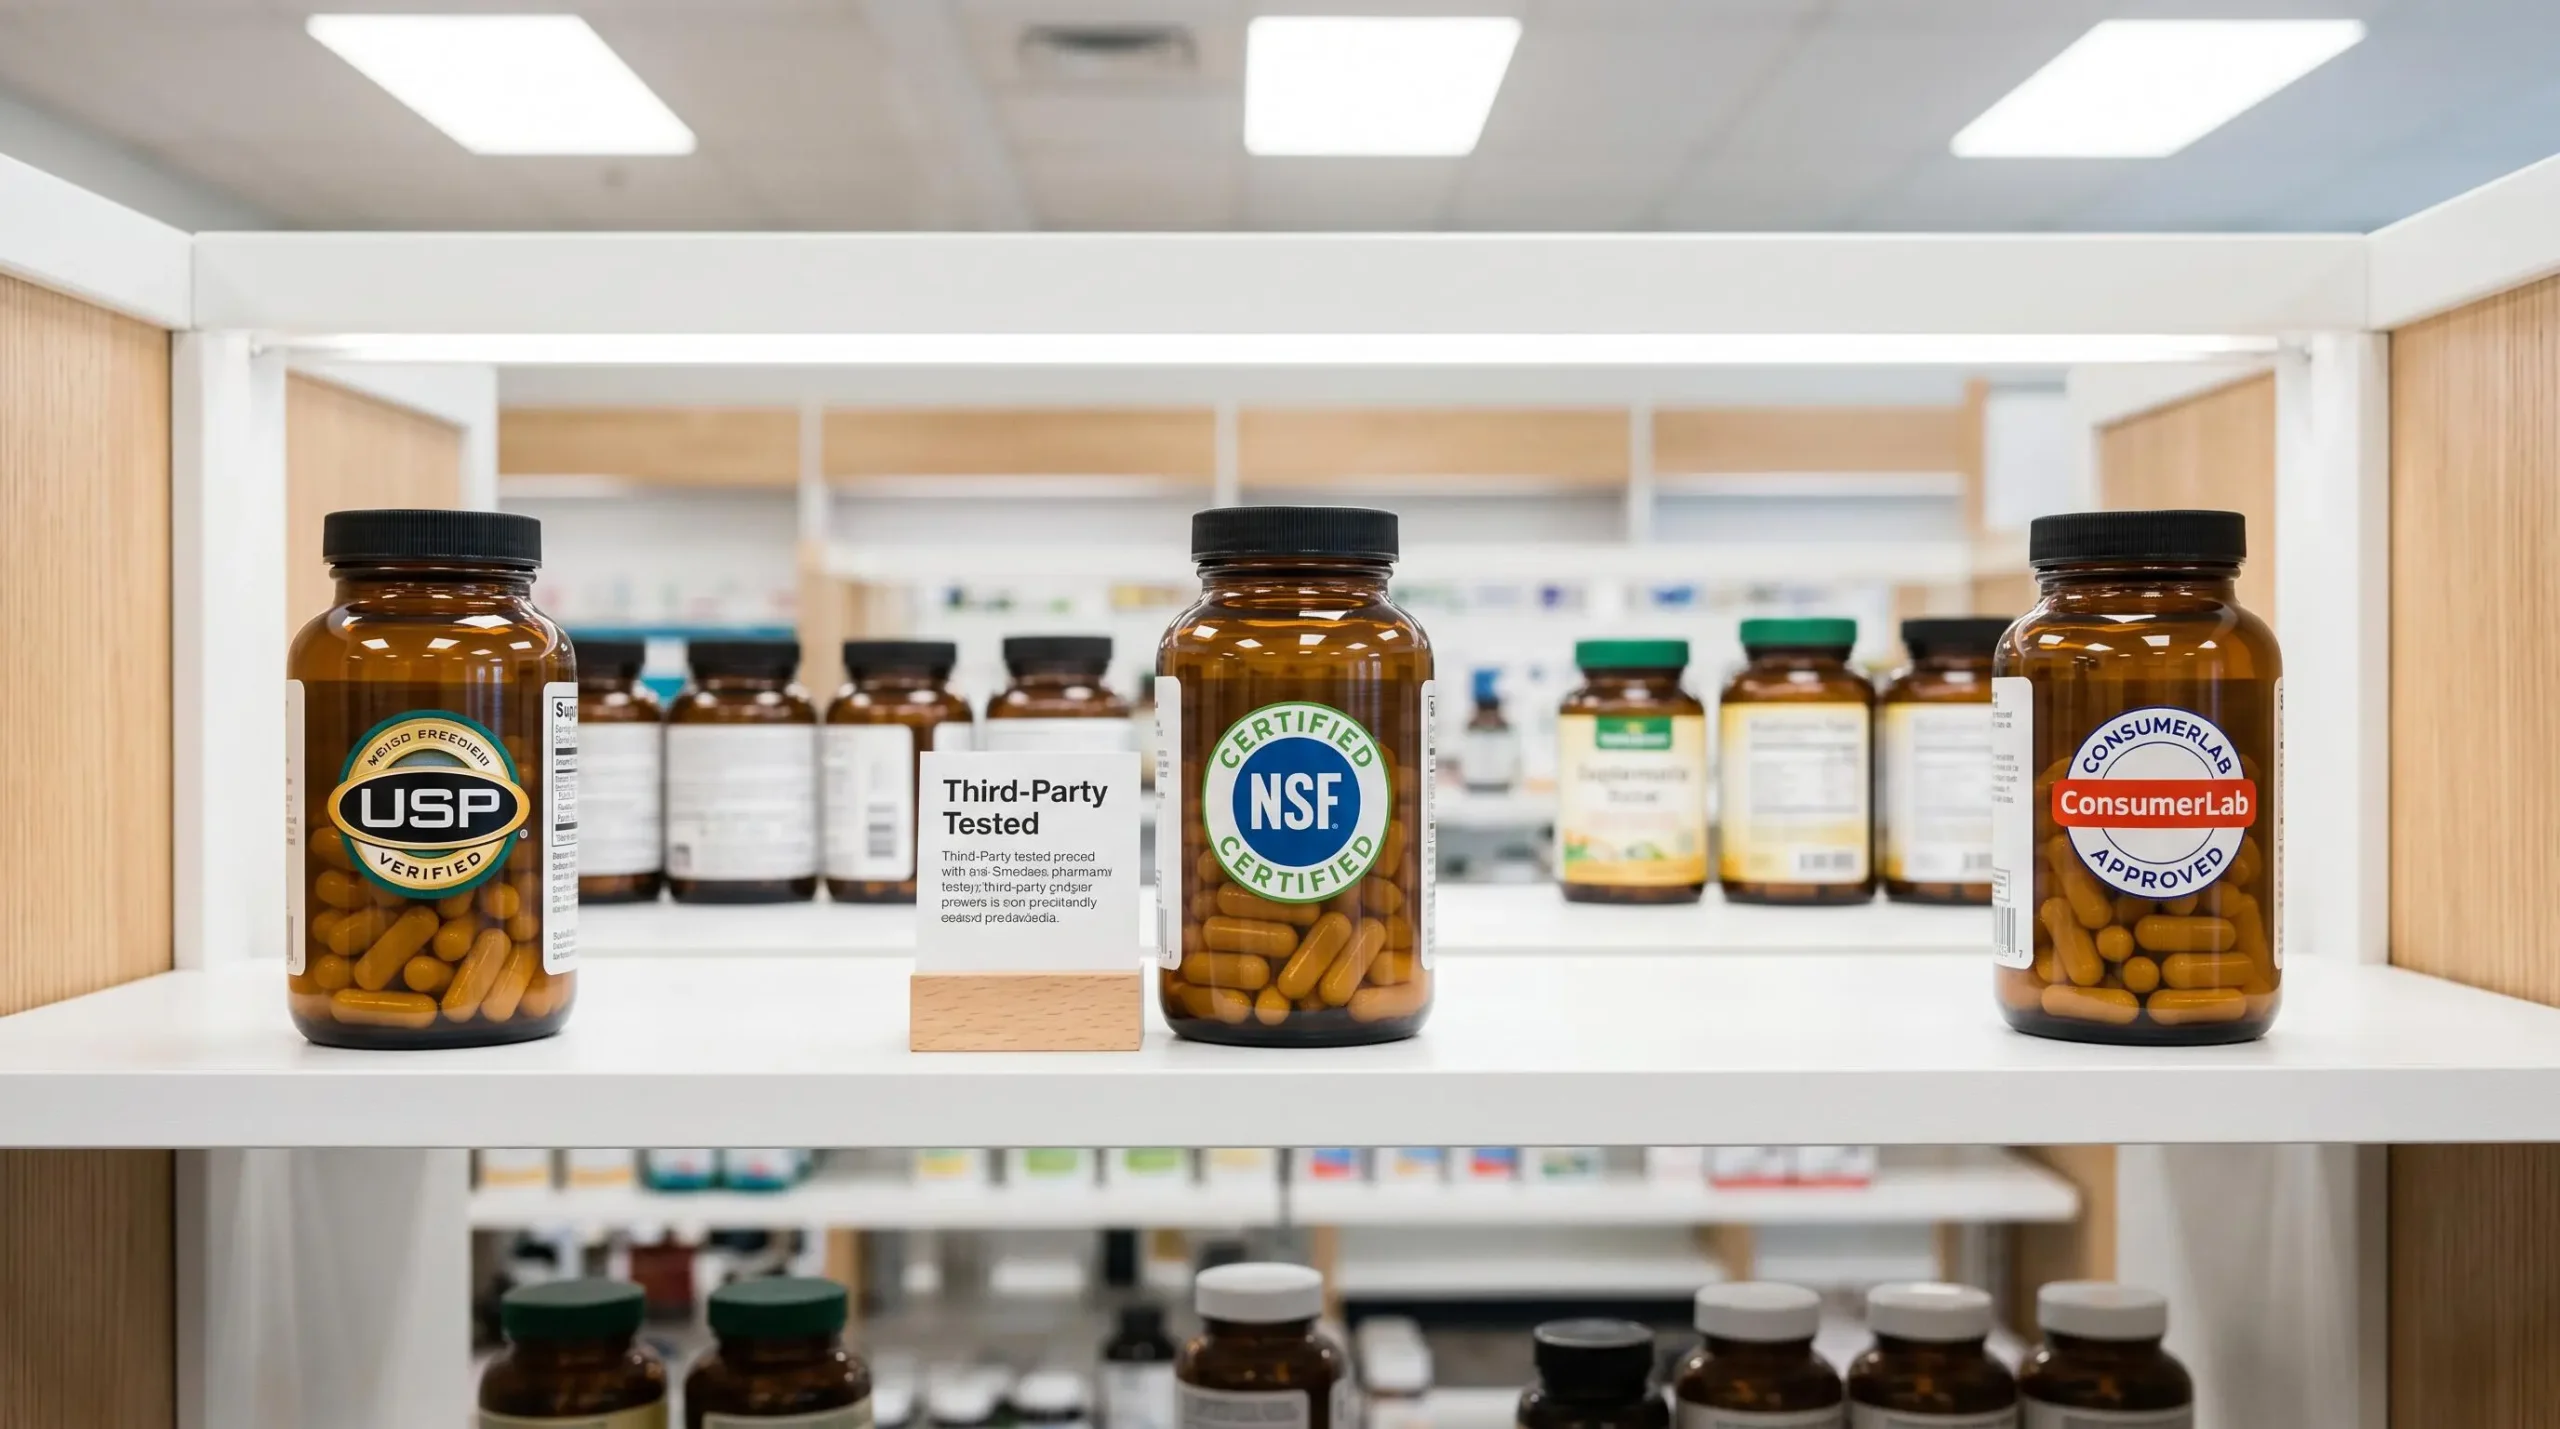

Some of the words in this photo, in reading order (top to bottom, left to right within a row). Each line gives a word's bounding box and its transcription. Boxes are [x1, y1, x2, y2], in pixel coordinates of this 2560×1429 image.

[1219, 711, 1373, 769] CERTIFIED
[2083, 717, 2232, 775] CONSUMERLAB
[943, 779, 1108, 808] Third-Party
[1250, 772, 1342, 830] NSF
[2060, 790, 2249, 816] ConsumerLab
[361, 788, 500, 829] USP
[943, 811, 1039, 835] Tested
[380, 852, 481, 880] VERIFIED
[942, 867, 966, 877] with
[1015, 851, 1051, 862] tested
[1053, 851, 1095, 864] preced
[1219, 835, 1373, 893] CERTIFIED
[2090, 847, 2223, 890] APPROVED
[990, 897, 1000, 907] is
